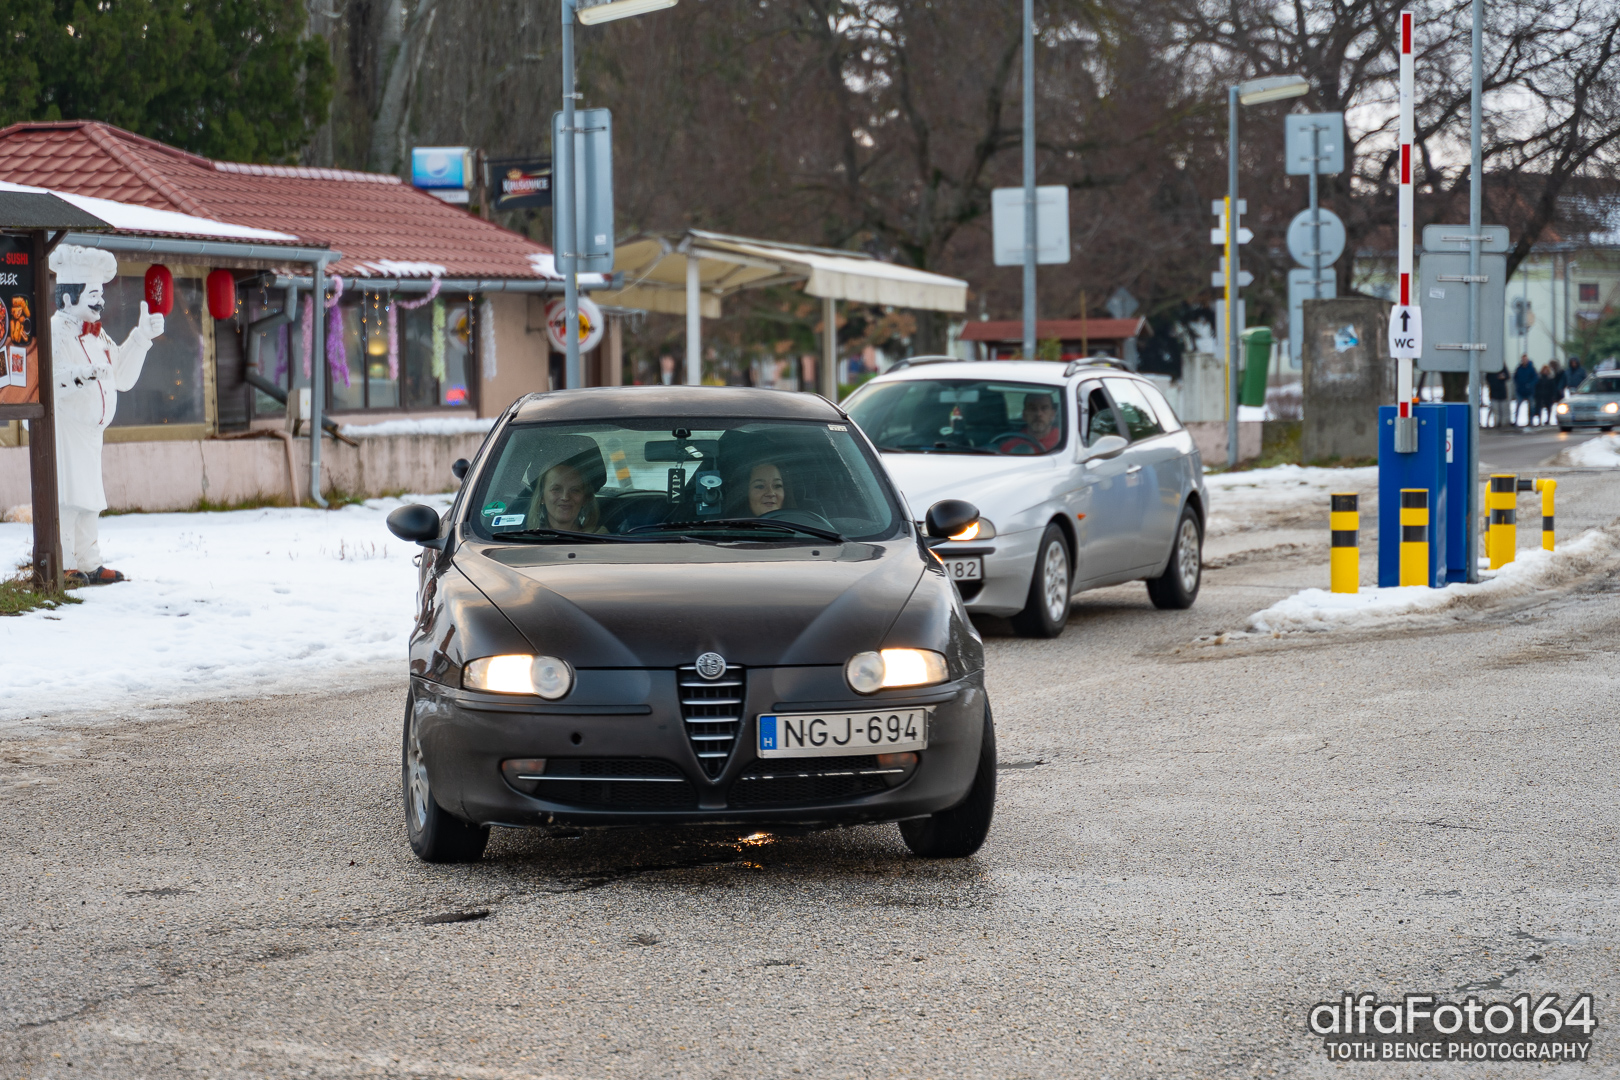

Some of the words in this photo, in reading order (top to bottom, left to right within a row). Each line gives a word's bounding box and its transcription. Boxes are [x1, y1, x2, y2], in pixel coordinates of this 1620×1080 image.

[6, 252, 29, 265] SUSHI
[0, 272, 18, 286] ELEK
[1394, 338, 1415, 349] WC
[671, 474, 681, 499] VIP
[492, 501, 499, 509] 4
[763, 736, 773, 748] H
[784, 713, 918, 748] NGJ-694
